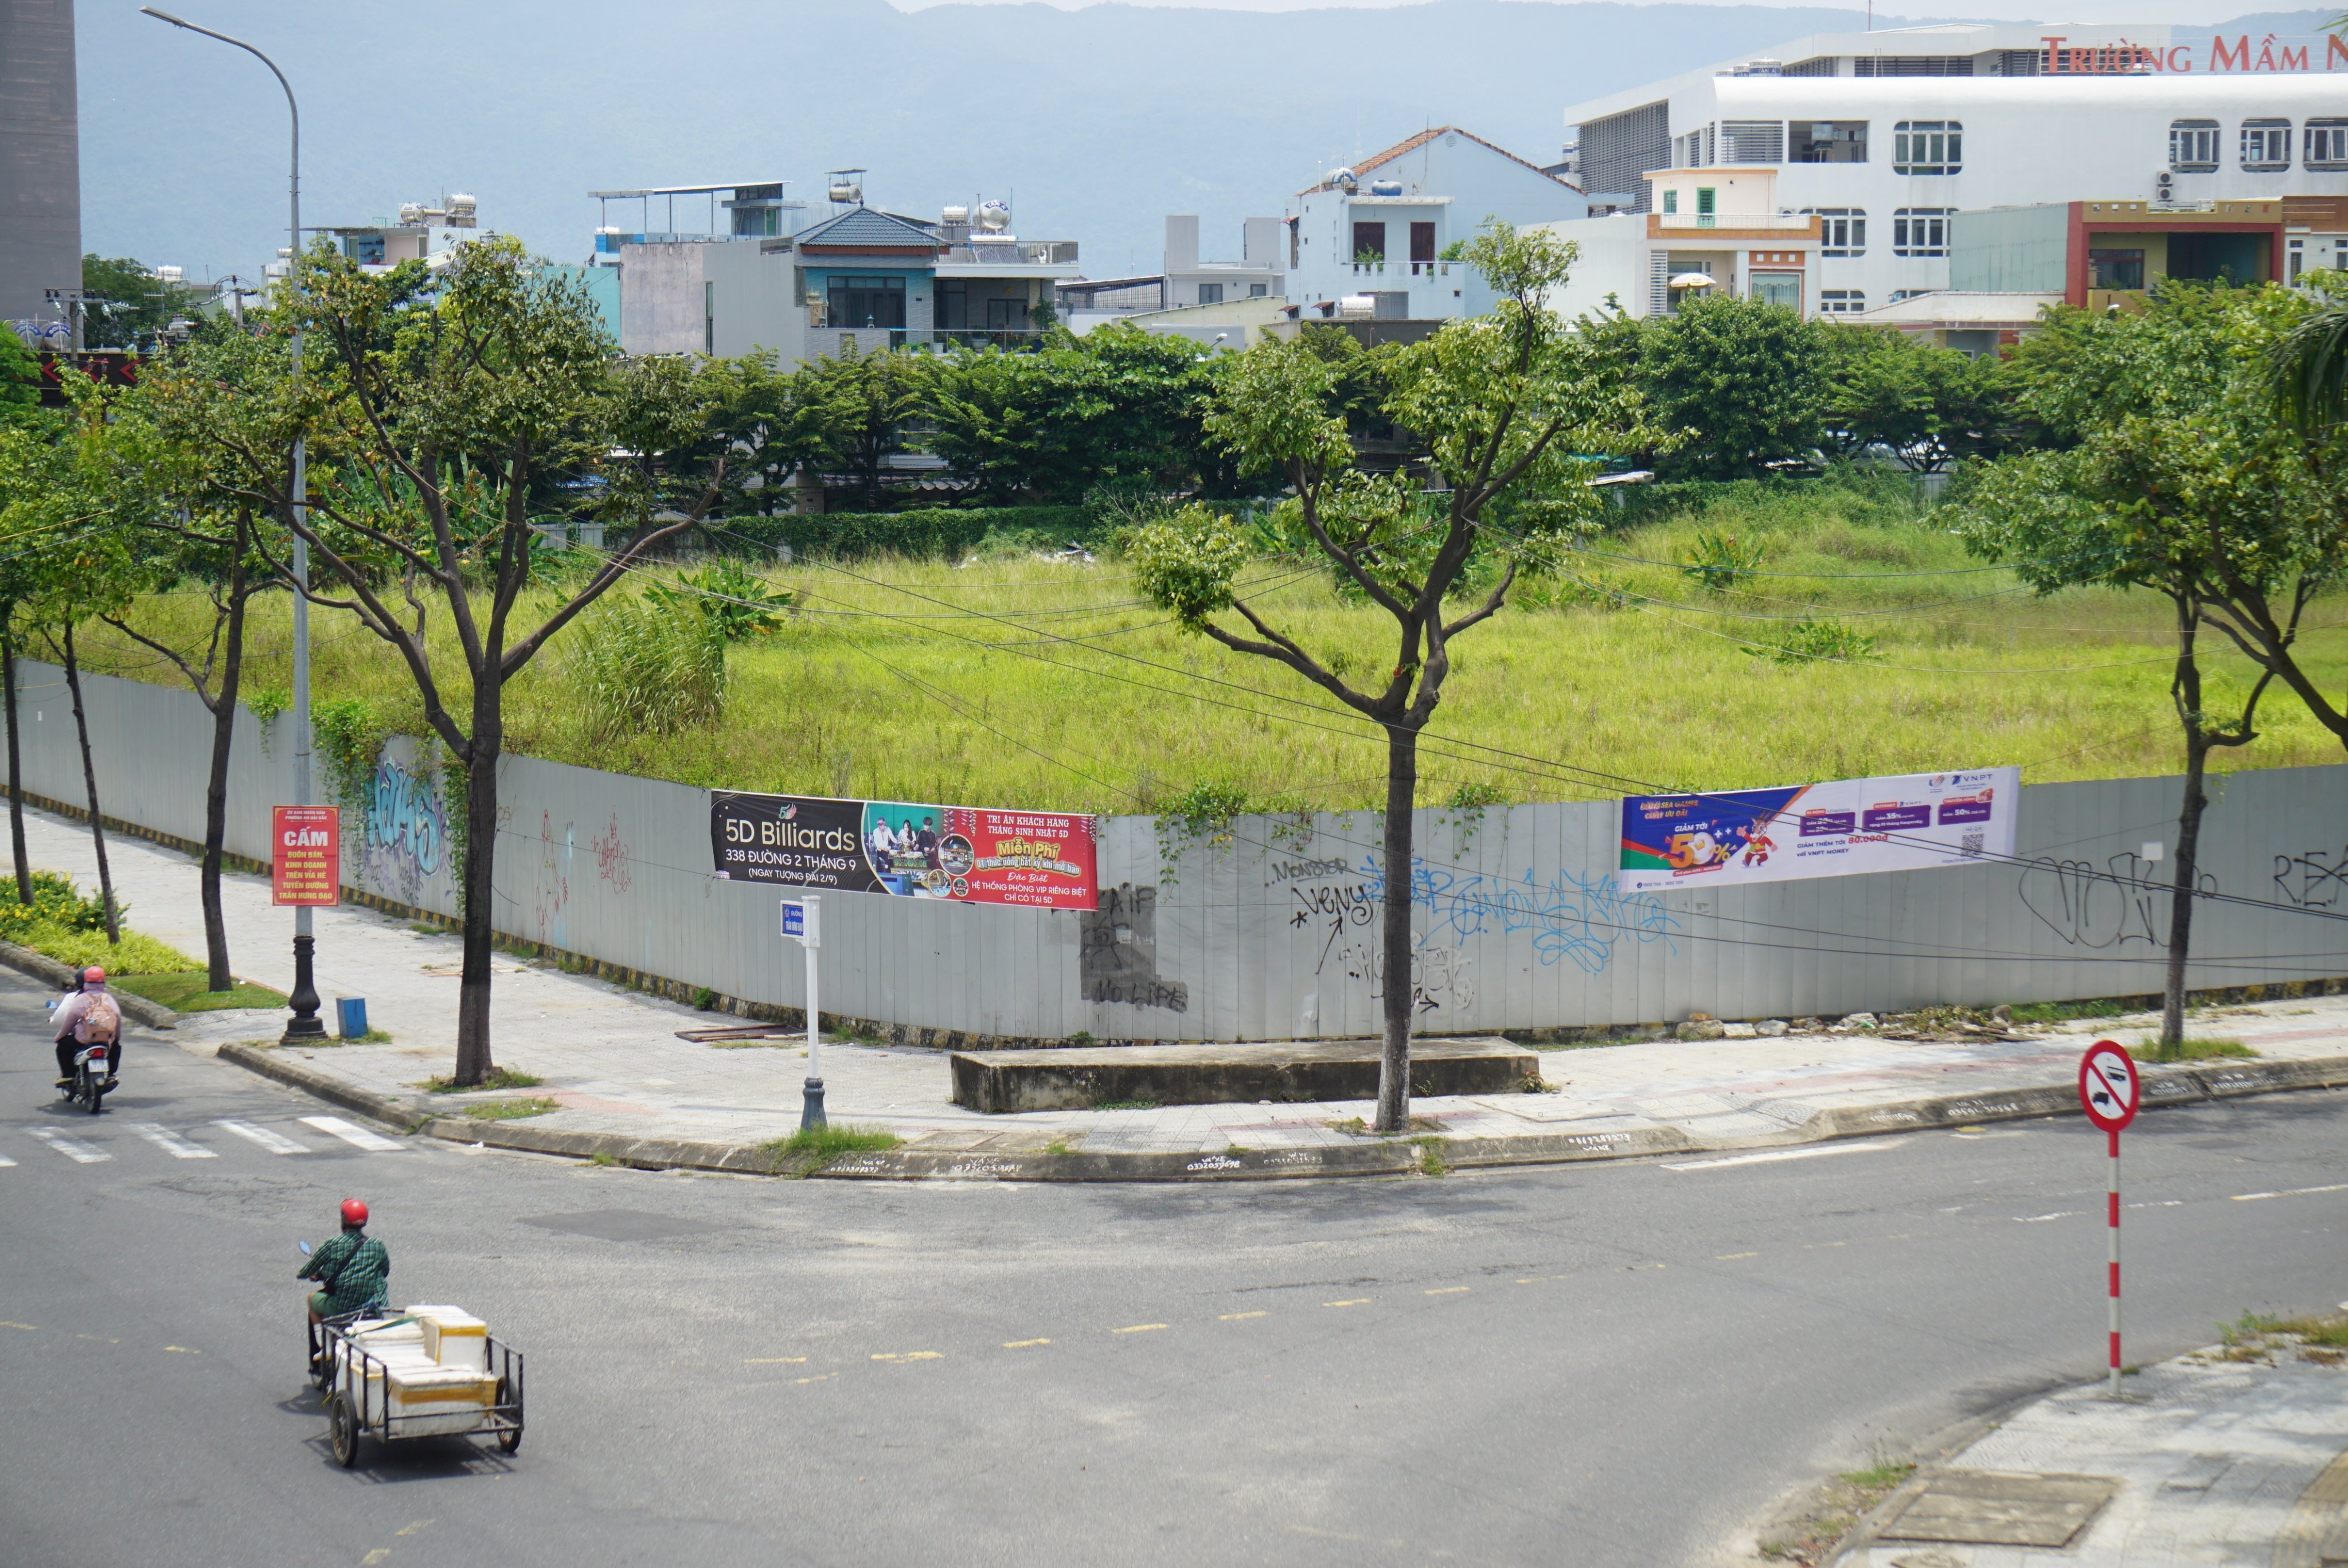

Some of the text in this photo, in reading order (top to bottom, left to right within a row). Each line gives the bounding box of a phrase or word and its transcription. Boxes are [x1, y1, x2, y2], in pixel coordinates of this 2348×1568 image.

[2041, 37, 2191, 73] TRƯỜNG
[2210, 33, 2309, 72] MẦM
[987, 814, 1069, 828] TRI ÂN KHÁCH HÀNG
[1674, 822, 1708, 832] GIẢM TỚI
[284, 826, 328, 847] CẤM
[725, 819, 855, 851] 5D Billiards
[987, 825, 1069, 838] THÁNG SINH NHẬT 5D
[997, 838, 1060, 860] Miễn Phí
[725, 848, 856, 871] 338 ĐƯỜNG 2 THÁNG 9
[1003, 856, 1019, 869] uống
[1020, 855, 1032, 868] bất
[1042, 859, 1053, 869] khi
[304, 870, 315, 878] VỈA
[748, 867, 838, 886] (NGAY TƯỢNG ĐÀI 2/9)
[1007, 871, 1049, 883] Đặc Biệt
[283, 881, 303, 889] TUYẾN
[971, 880, 980, 891] HỆ
[982, 881, 1007, 891] THỐNG
[1009, 883, 1034, 893] PHÒNG
[1048, 885, 1070, 895] RIÊNG
[1072, 887, 1087, 898] BIỆT
[279, 891, 296, 899] TRẦN
[318, 892, 333, 901] ĐẠO
[1004, 893, 1017, 902] CHỈ
[1018, 893, 1029, 902] CÓ
[1031, 896, 1042, 905] TẠI
